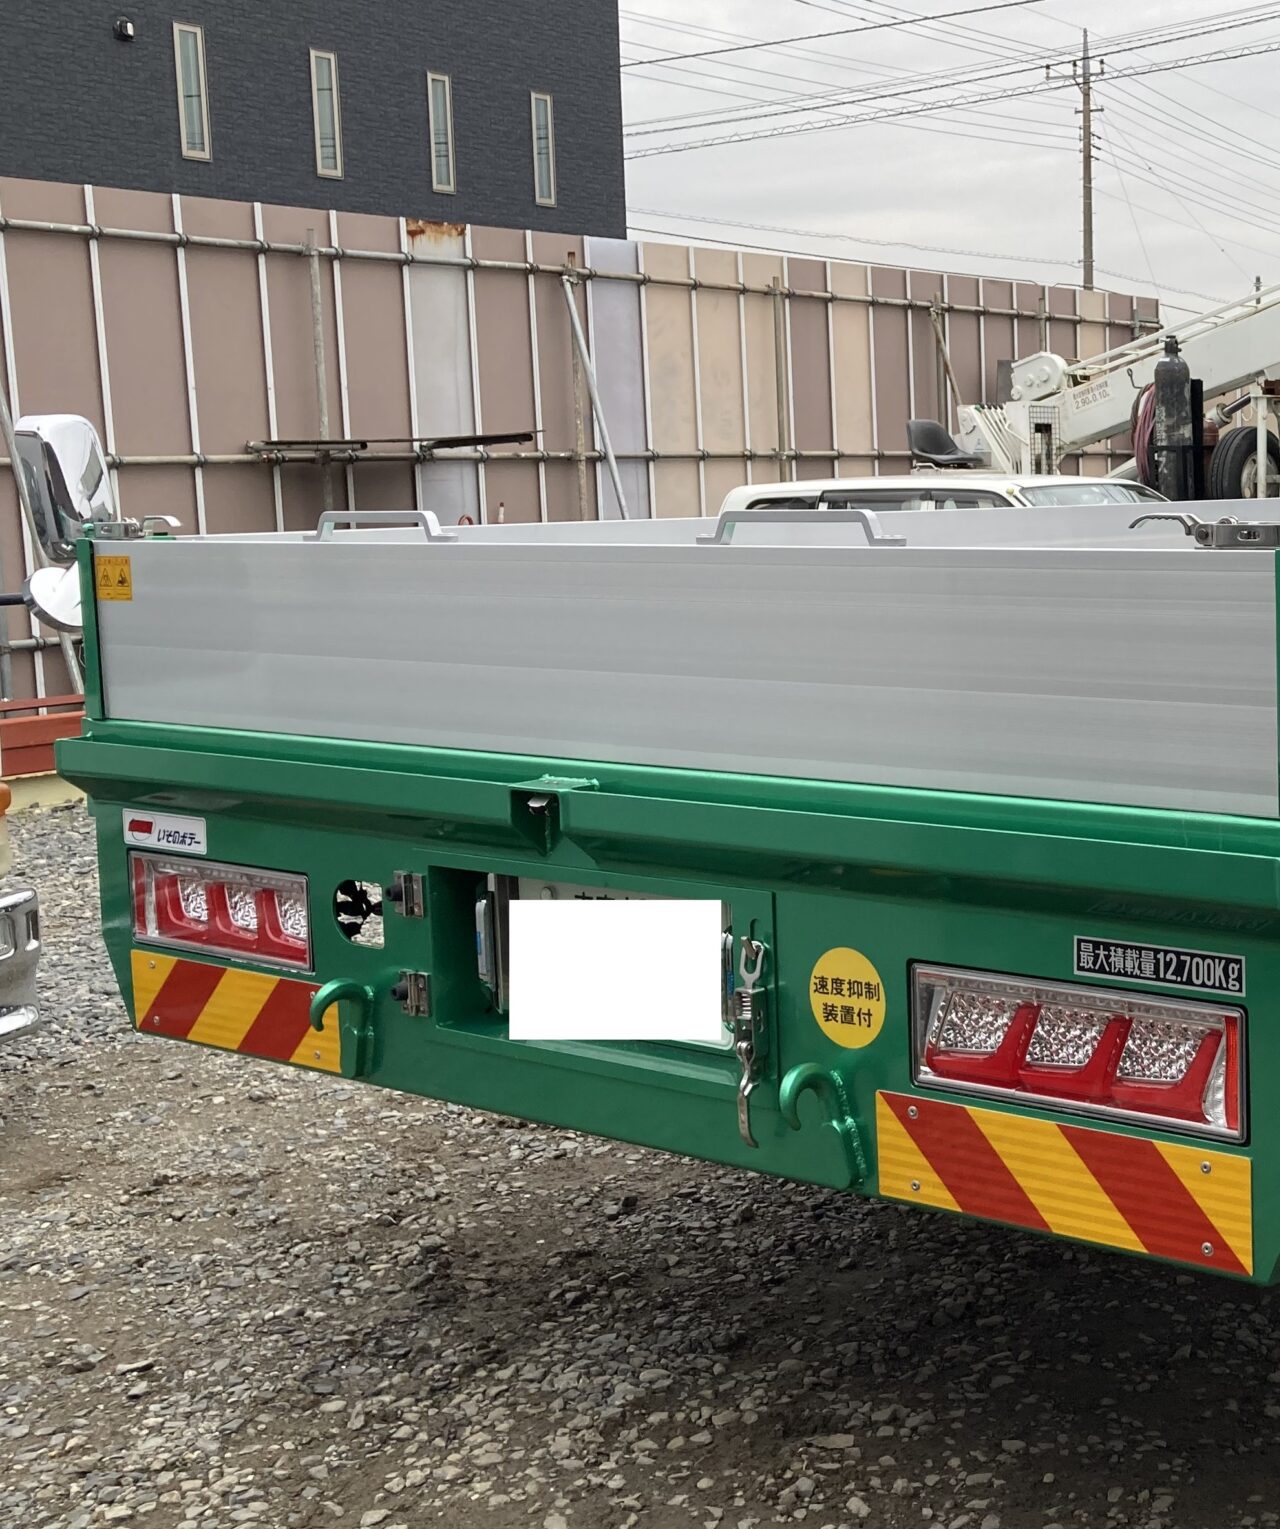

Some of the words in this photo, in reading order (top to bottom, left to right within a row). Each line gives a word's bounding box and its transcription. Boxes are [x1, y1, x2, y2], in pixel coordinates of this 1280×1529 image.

[157, 829, 201, 846] いそのボデー
[813, 975, 880, 1002] 速度抑制
[822, 1002, 873, 1028] 装置付
